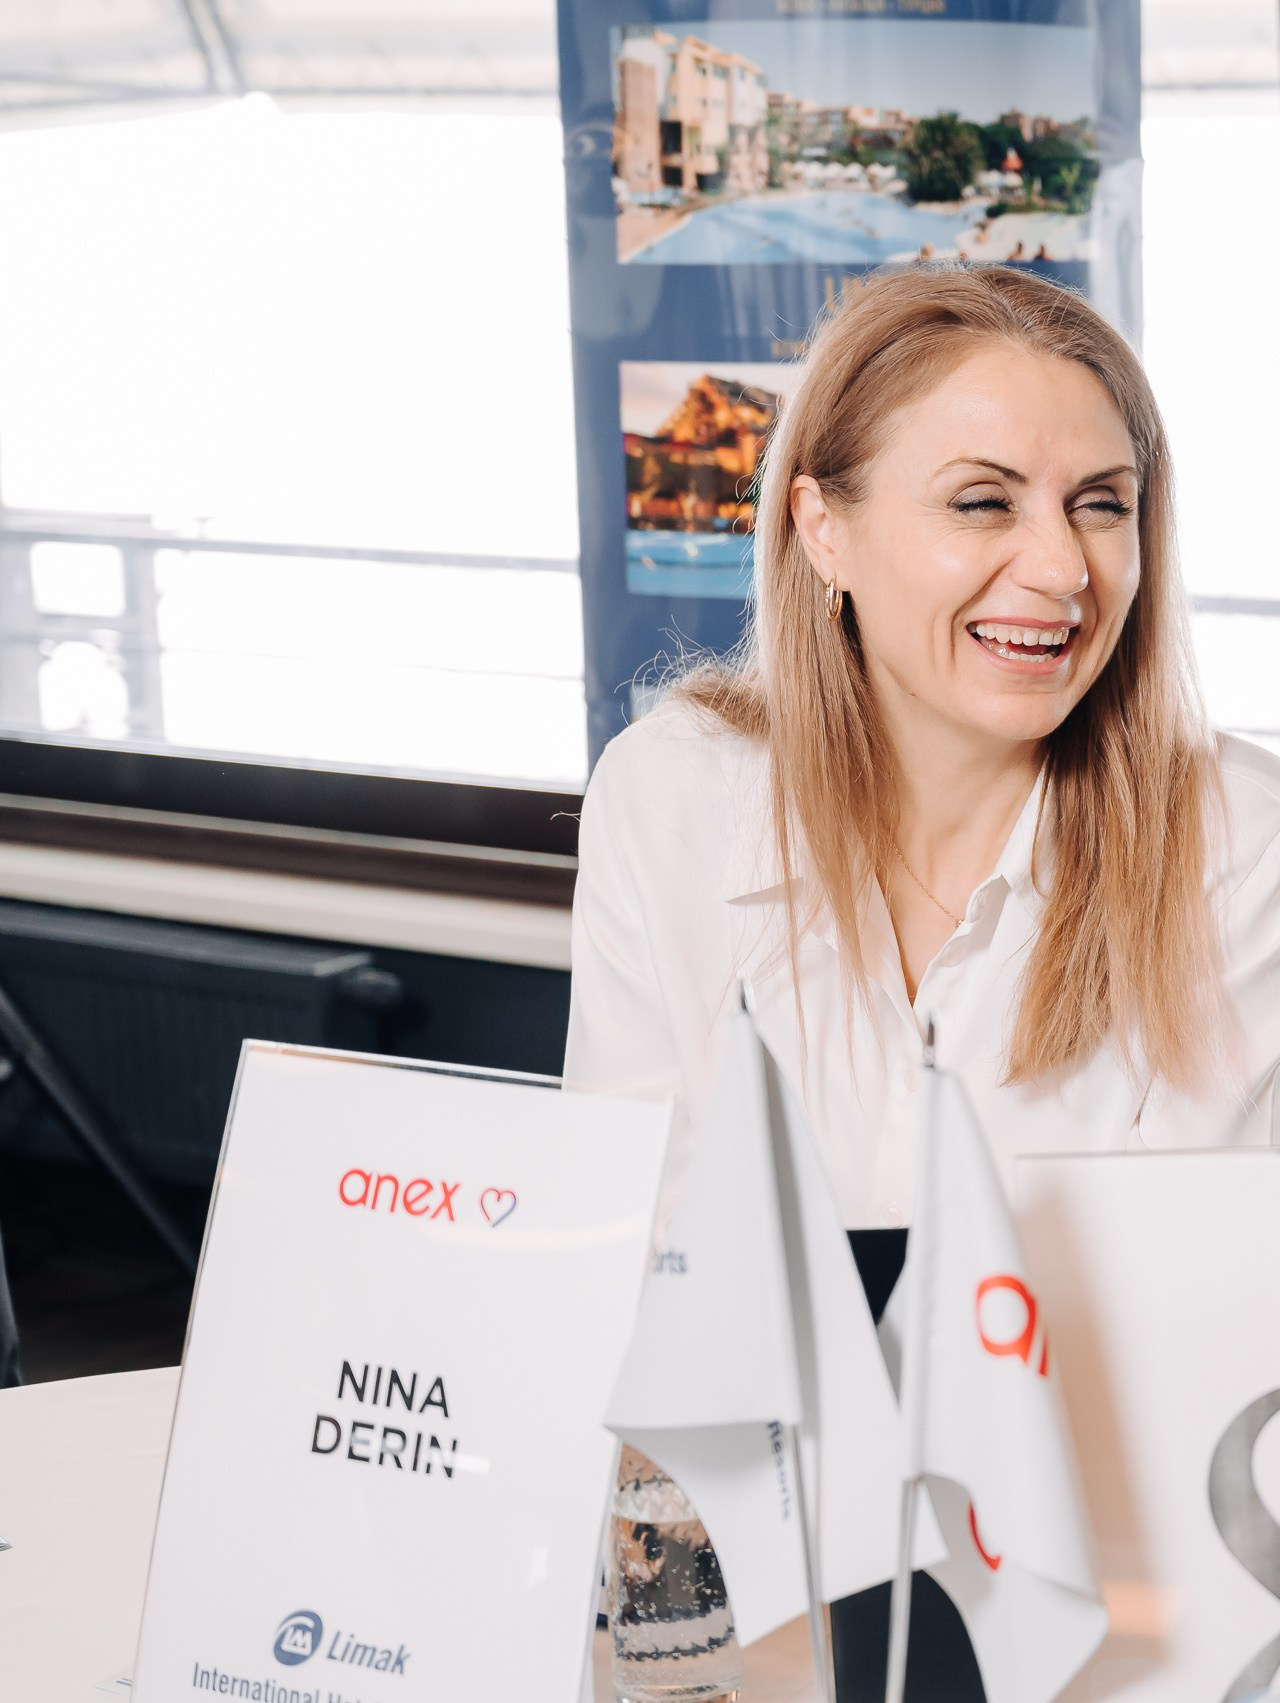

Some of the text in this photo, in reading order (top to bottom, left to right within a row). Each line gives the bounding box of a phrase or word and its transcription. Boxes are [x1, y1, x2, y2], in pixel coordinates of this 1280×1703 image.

[339, 1168, 460, 1222] anex
[338, 1360, 449, 1418] NINA
[312, 1414, 457, 1478] DERIN
[326, 1630, 411, 1675] Limak
